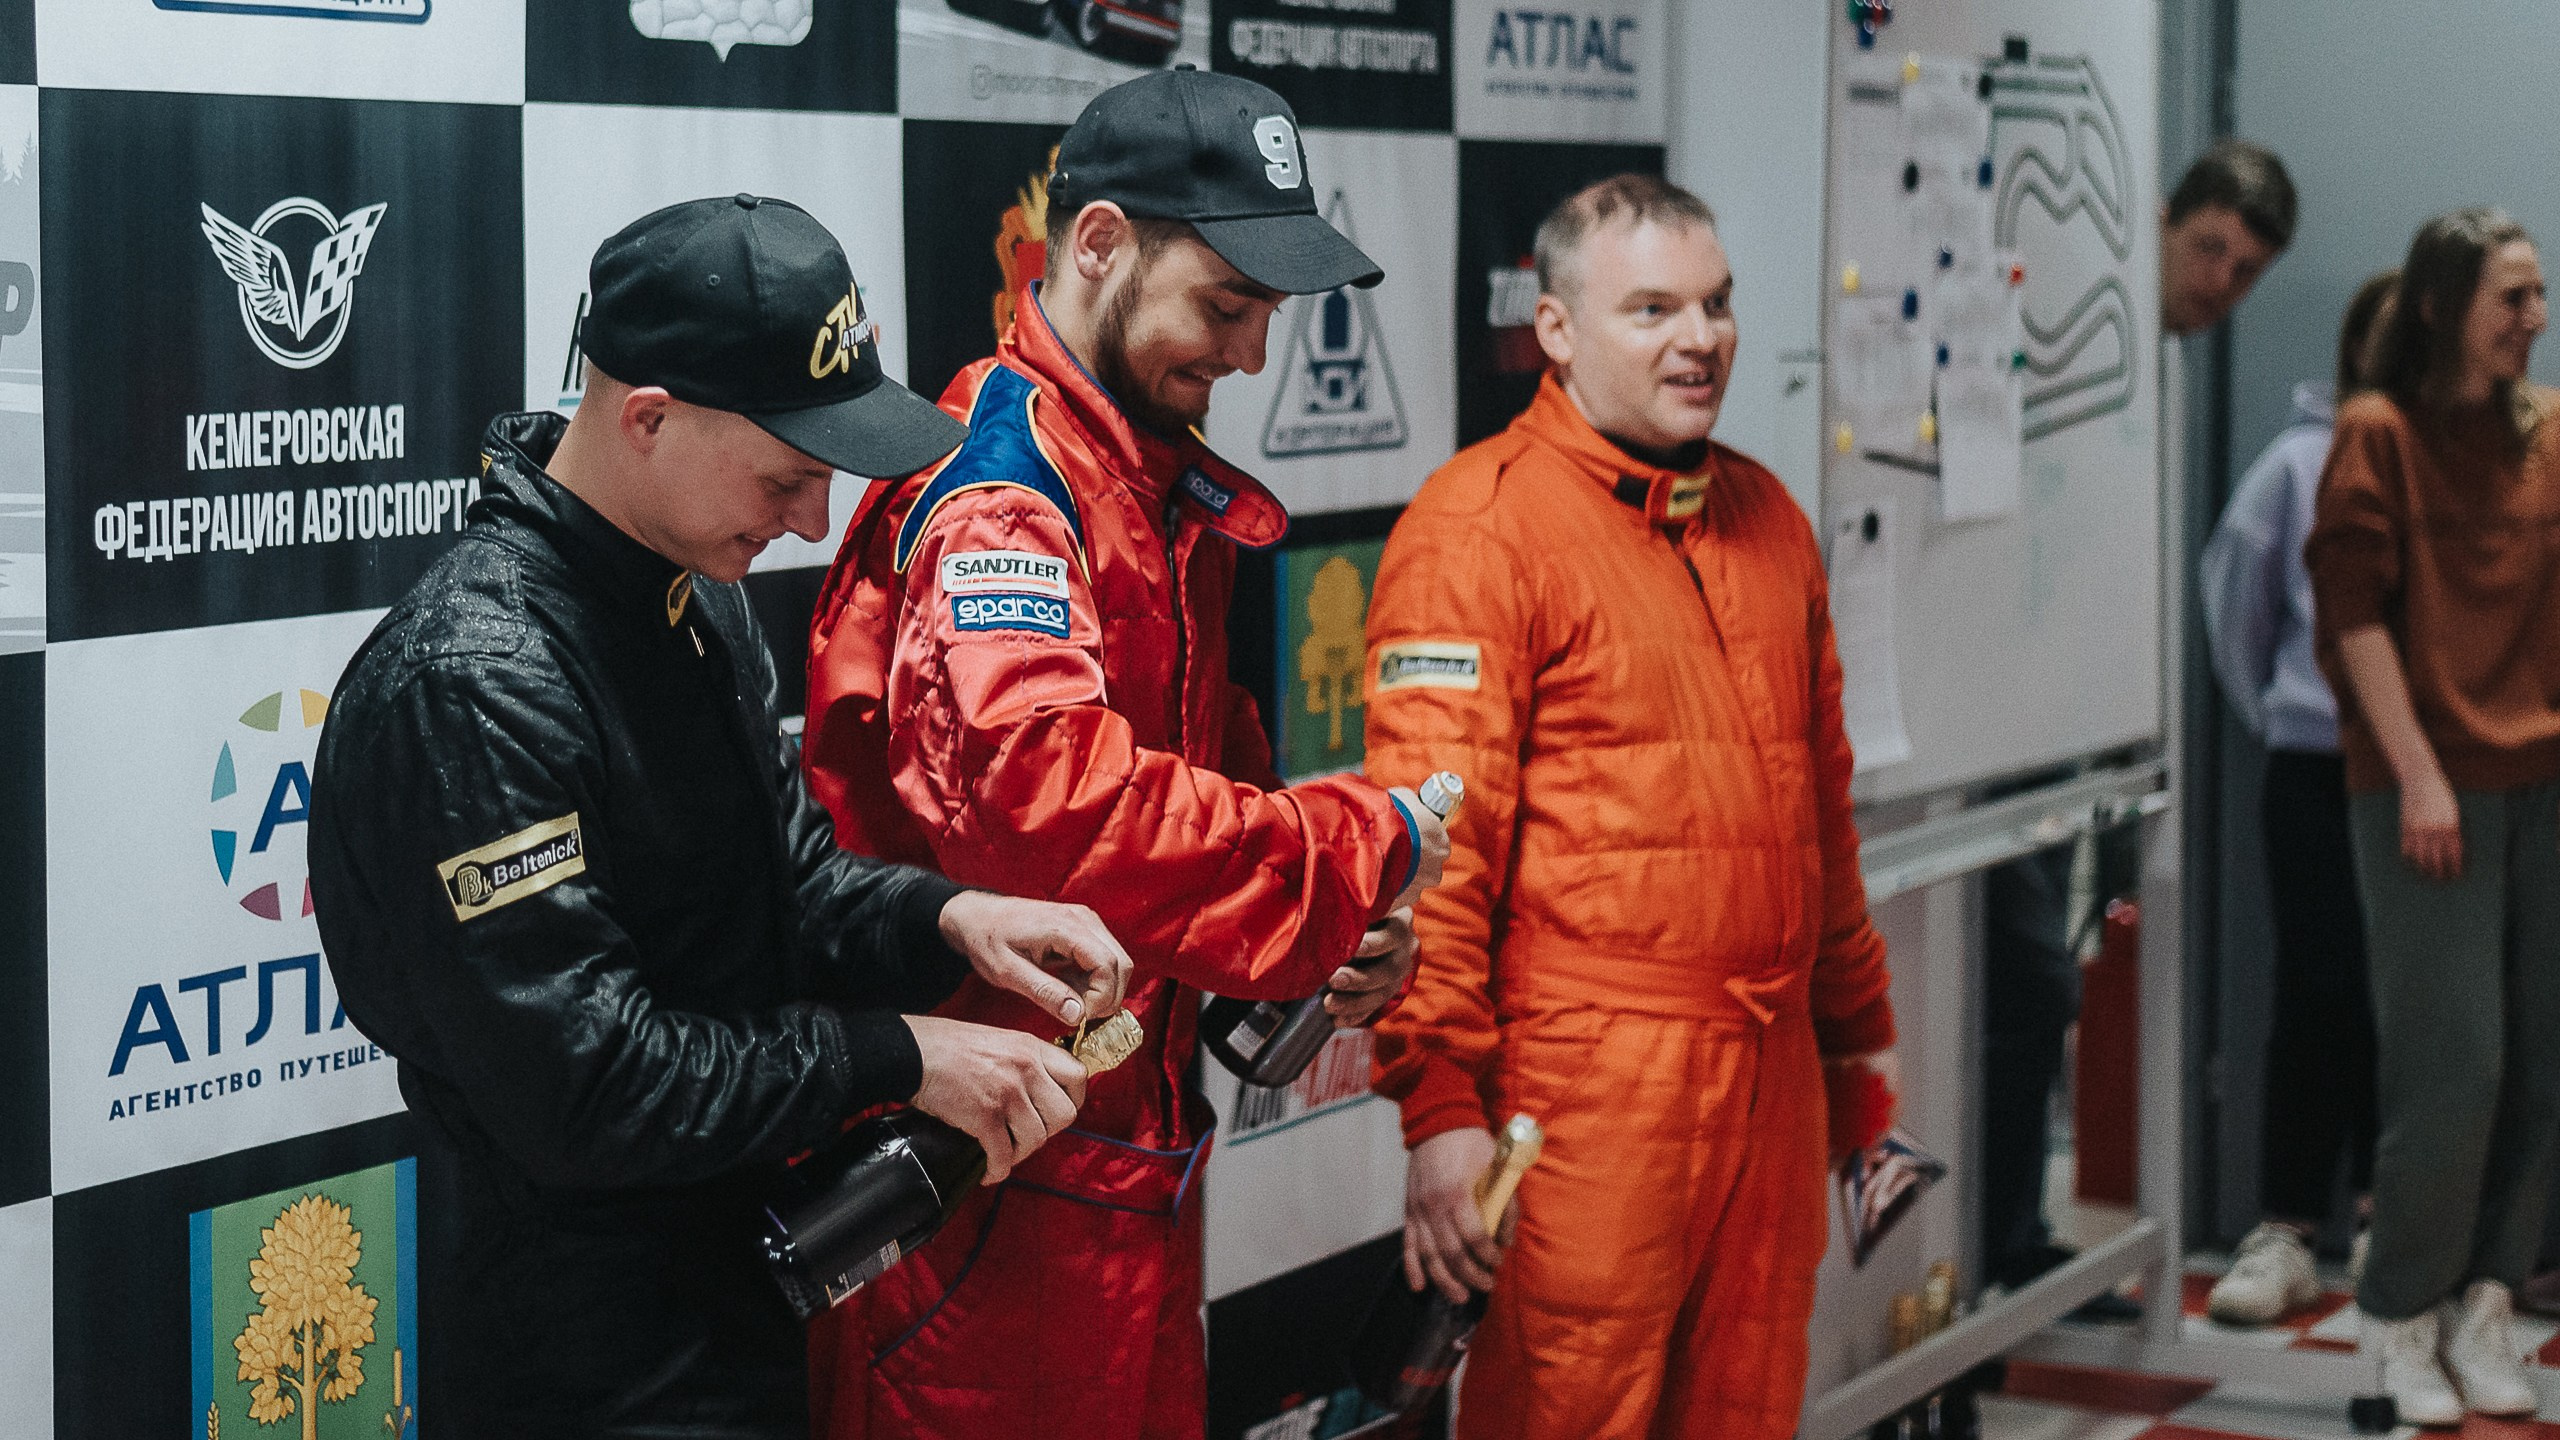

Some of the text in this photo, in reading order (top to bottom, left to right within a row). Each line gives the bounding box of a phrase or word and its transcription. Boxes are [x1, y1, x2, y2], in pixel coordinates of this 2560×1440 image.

[1486, 12, 1636, 73] АТЛАС
[1252, 114, 1302, 189] 9
[186, 404, 405, 471] КЕМЕРОВСКАЯ
[94, 490, 295, 563] ФЕДЕРАЦИЯ
[954, 558, 1059, 580] SANDTLER
[493, 837, 577, 887] Beltenick
[107, 952, 348, 1077] АТЛ
[108, 1042, 392, 1121] АГЕНТСТВО ПУТЕШЕ
